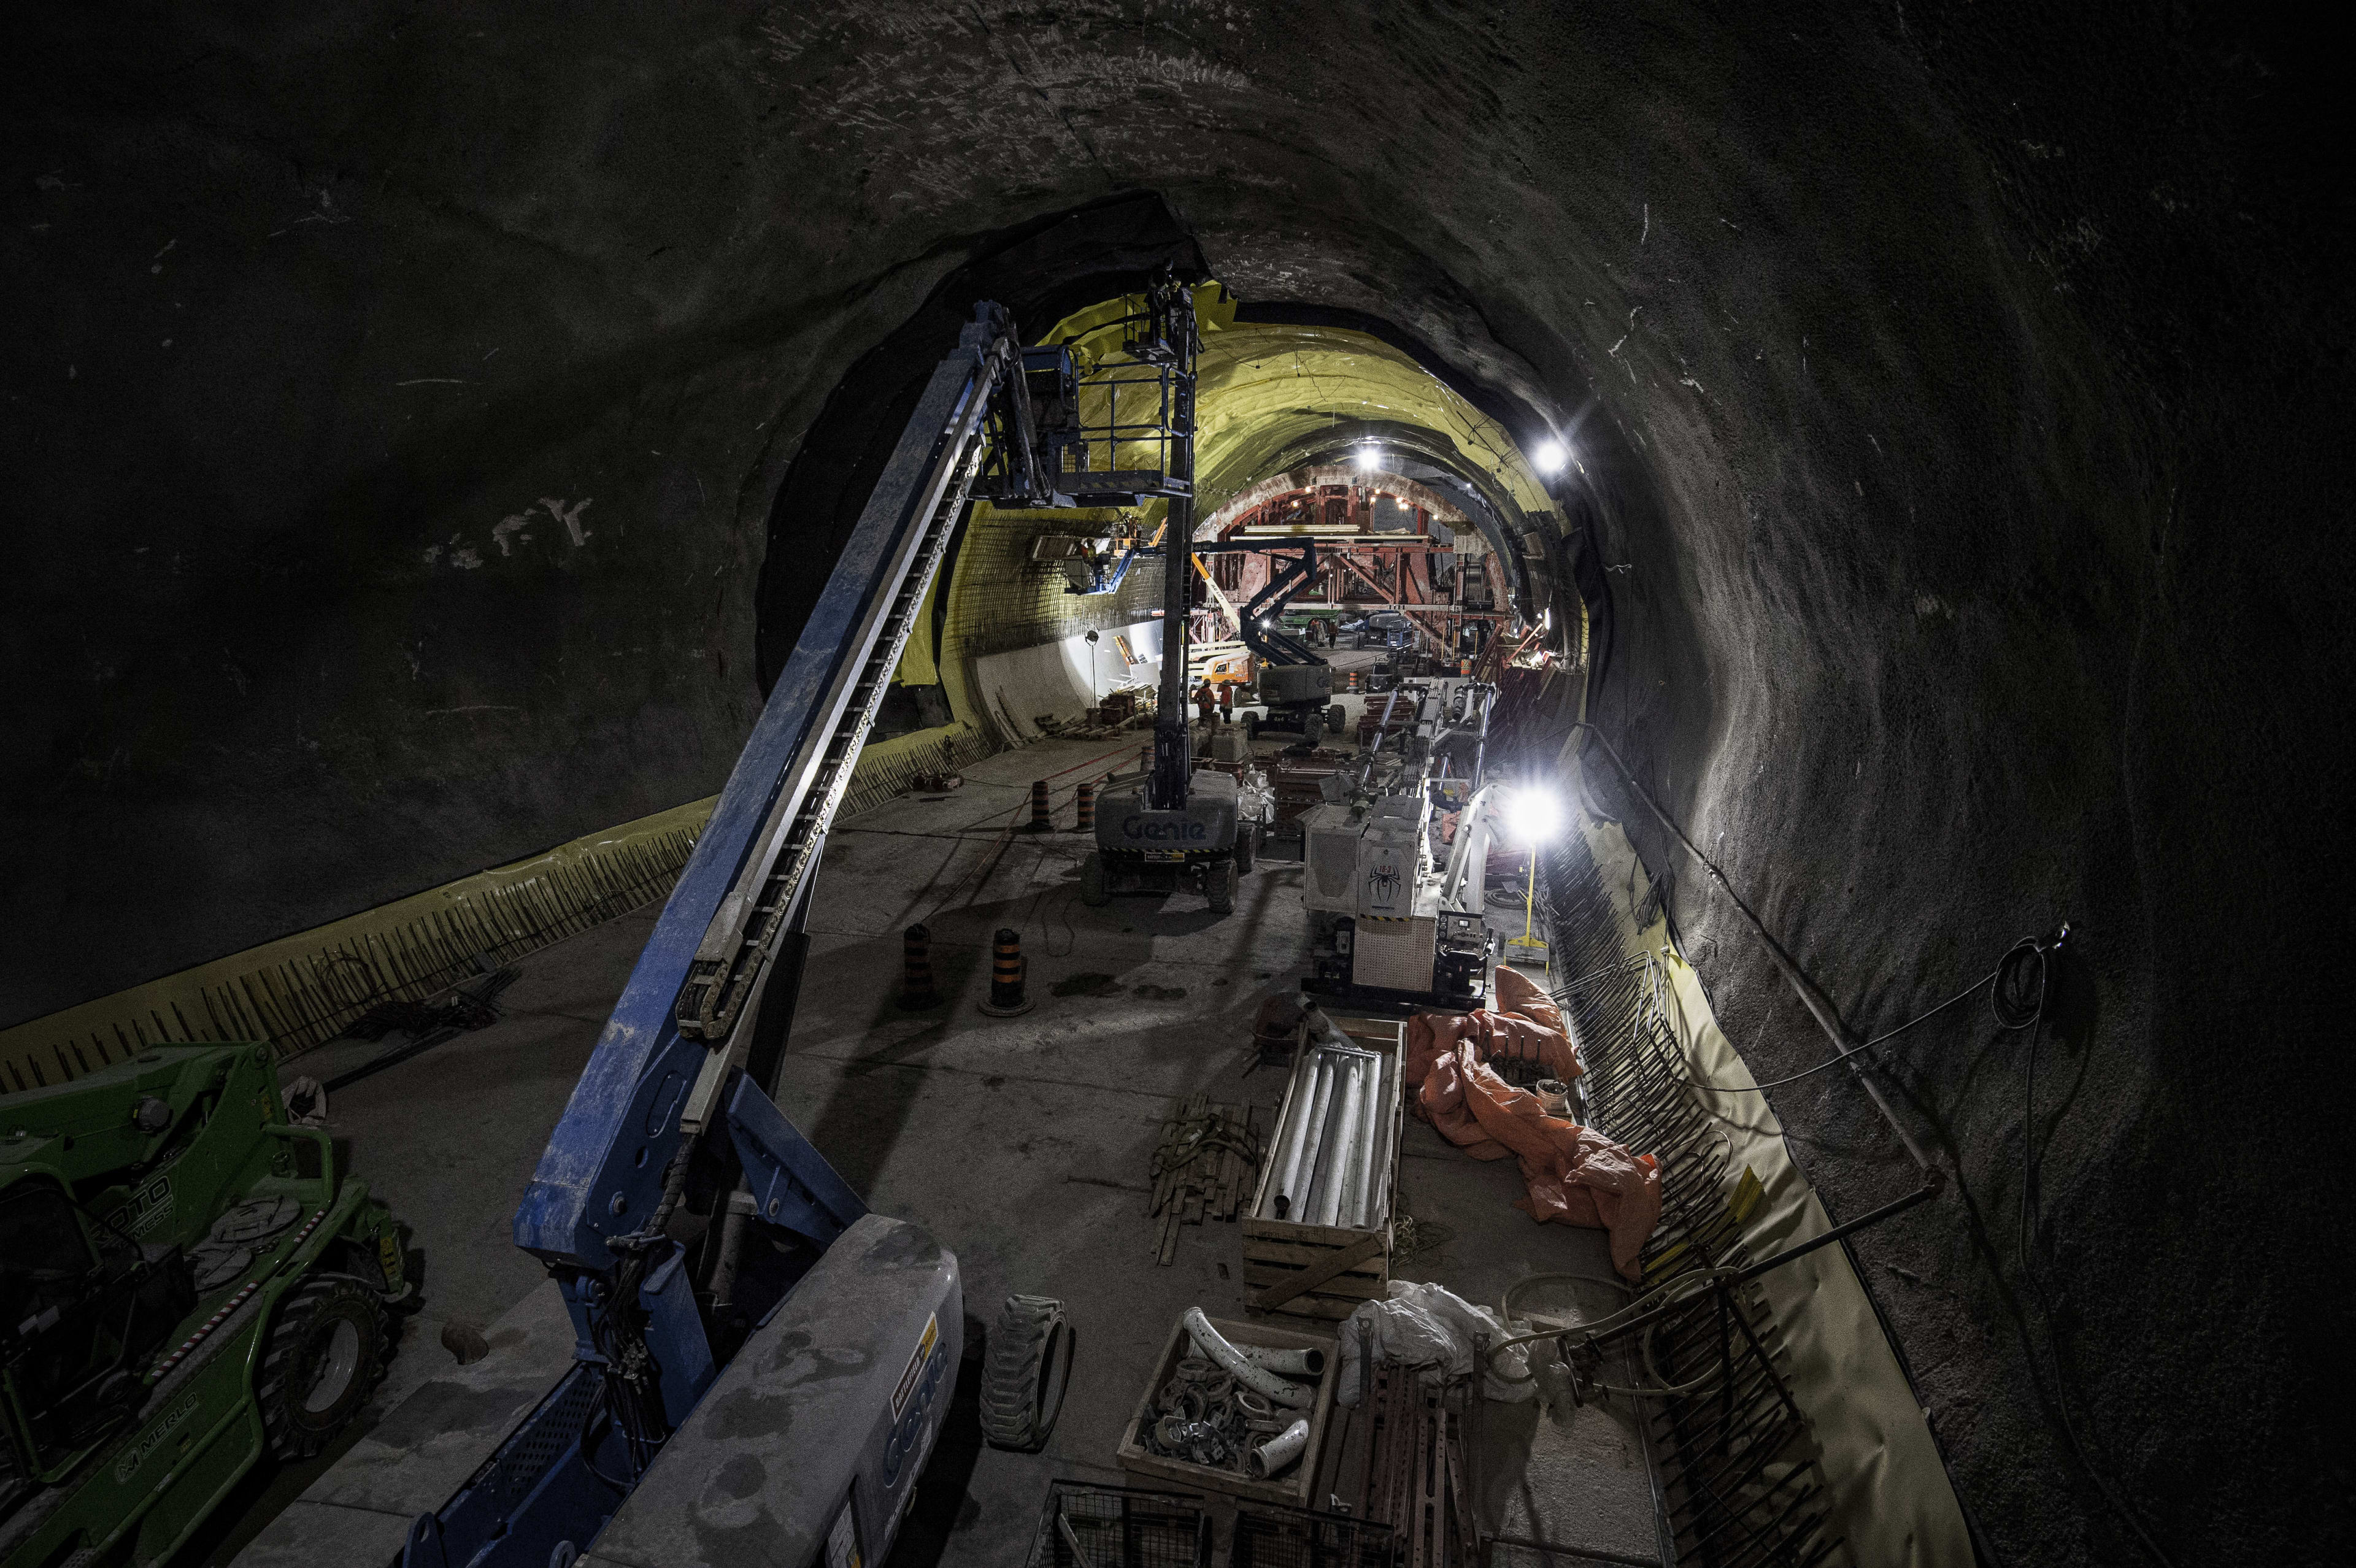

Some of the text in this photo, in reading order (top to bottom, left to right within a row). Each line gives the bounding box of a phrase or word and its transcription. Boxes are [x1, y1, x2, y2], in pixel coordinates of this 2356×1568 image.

[1123, 815, 1207, 840] Genie
[87, 1174, 172, 1244] ROTO
[131, 1202, 175, 1240] MCSS
[895, 1356, 922, 1409] BATTLEFIELD
[139, 1391, 198, 1451] MERLO
[882, 1341, 947, 1488] Genie
